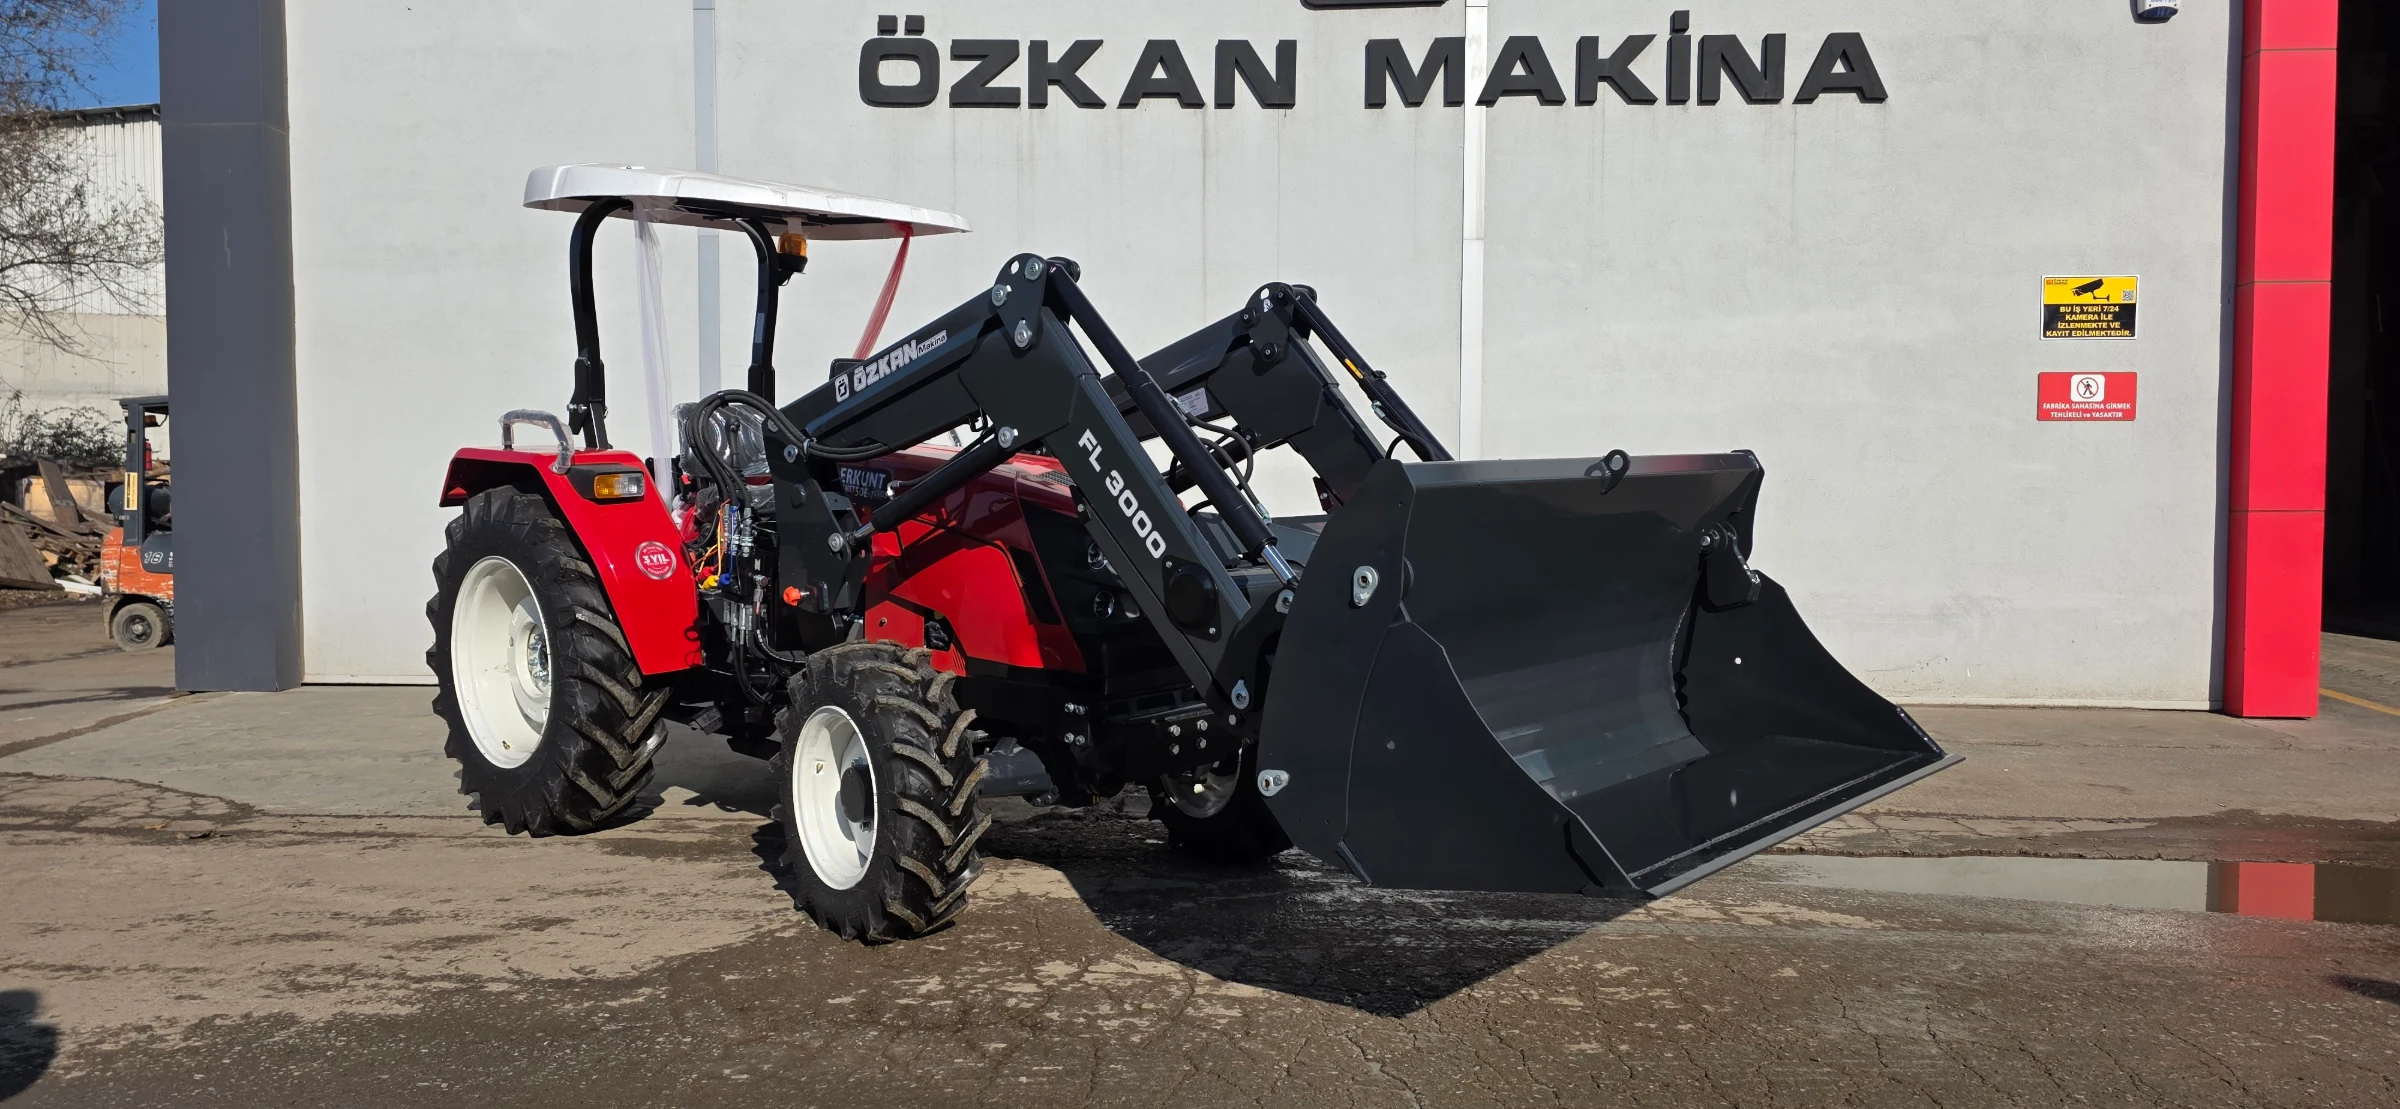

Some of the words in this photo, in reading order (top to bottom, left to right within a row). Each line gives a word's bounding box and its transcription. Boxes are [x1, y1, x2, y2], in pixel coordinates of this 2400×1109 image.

[858, 15, 1298, 109] ÖZKAN
[1363, 10, 1889, 109] MAKİNA
[2073, 305, 2081, 314] İŞ
[2057, 321, 2108, 329] İZLENMEKTE
[2071, 329, 2132, 337] EDİLMEKTEDİR.
[853, 339, 918, 392] ÖZKAN
[917, 334, 947, 355] Makina
[2106, 401, 2131, 409] GİRMEK
[840, 467, 887, 489] ERKUNT
[1078, 428, 1103, 473] FL
[1105, 469, 1167, 559] 3000
[642, 555, 651, 564] 3
[650, 553, 670, 563] YIL
